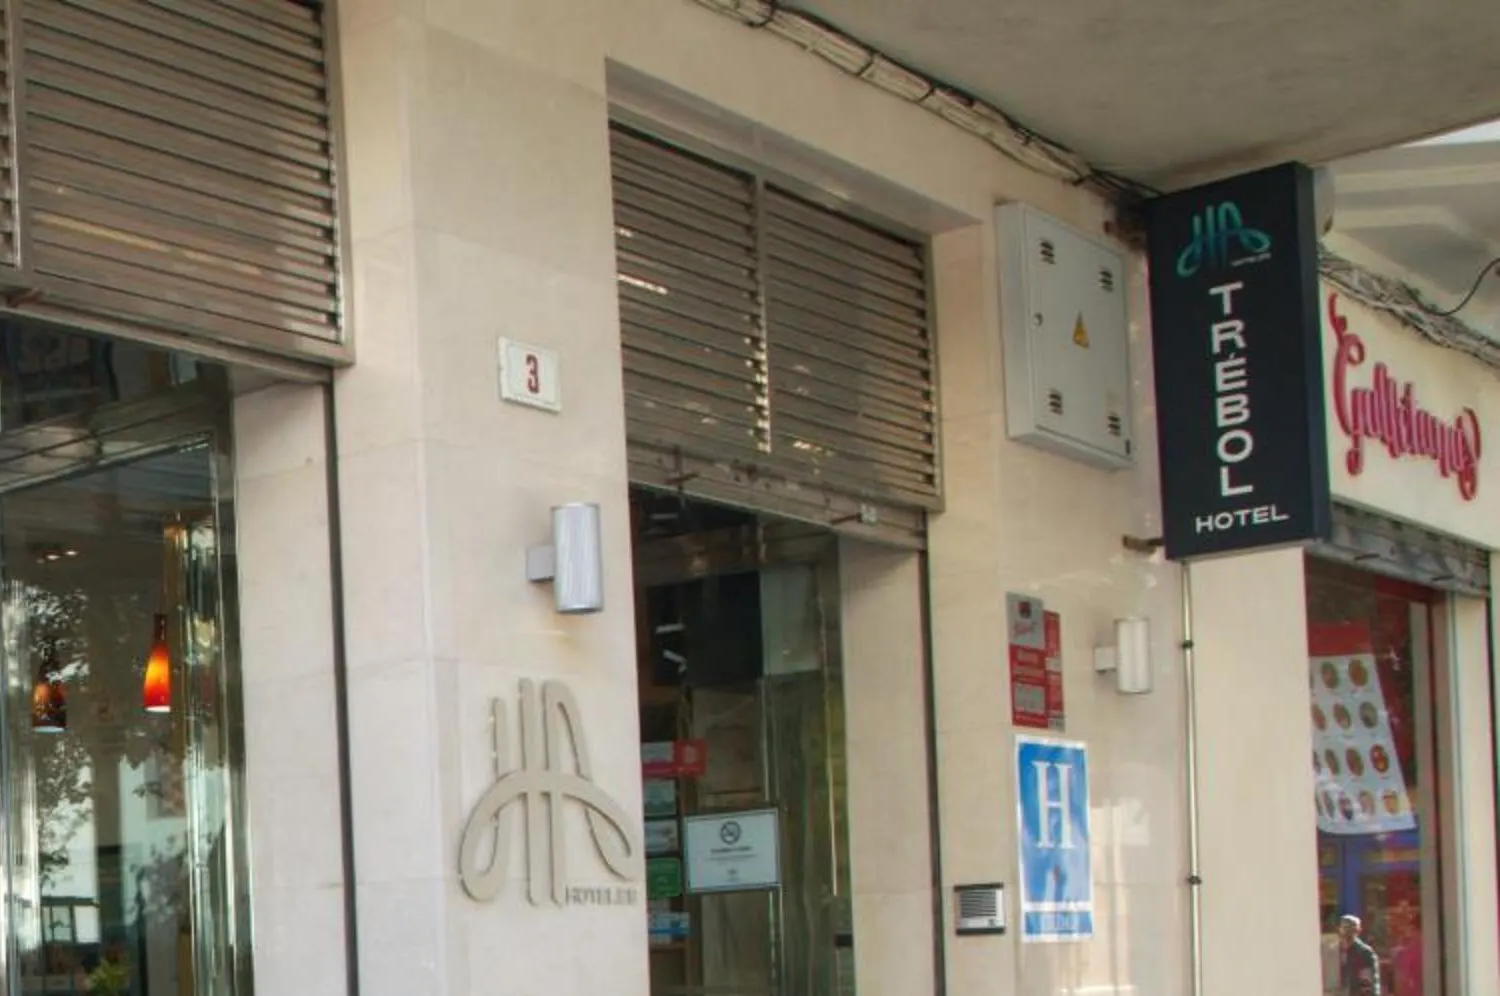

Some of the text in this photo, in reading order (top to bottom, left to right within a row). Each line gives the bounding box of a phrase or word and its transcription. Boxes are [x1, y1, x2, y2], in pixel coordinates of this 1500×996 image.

[526, 353, 540, 395] 3
[1195, 504, 1290, 534] HOTEL
[1032, 760, 1077, 850] H
